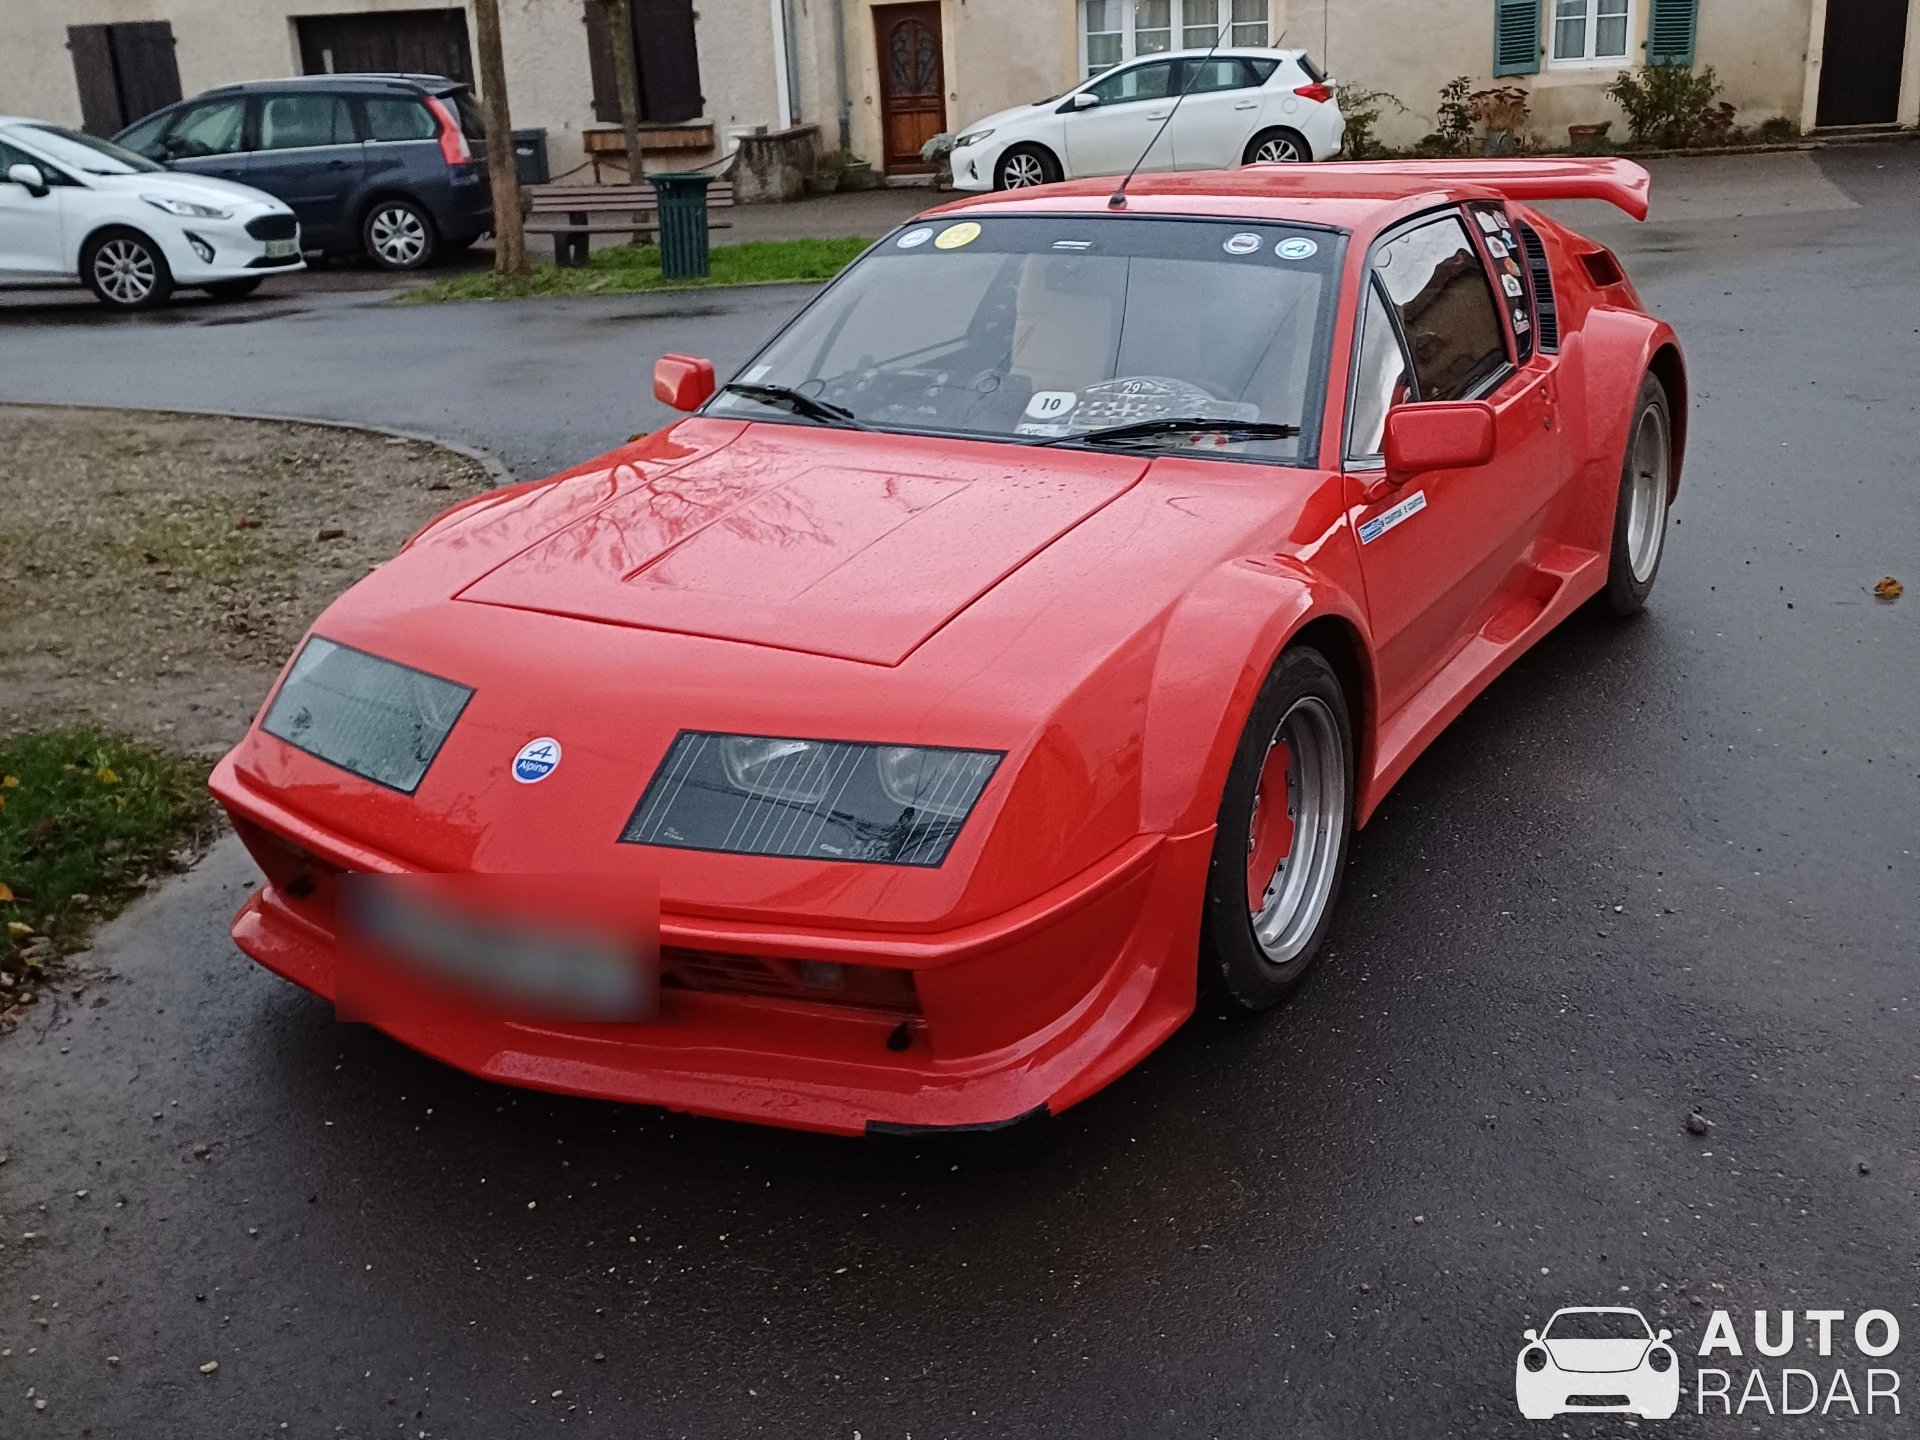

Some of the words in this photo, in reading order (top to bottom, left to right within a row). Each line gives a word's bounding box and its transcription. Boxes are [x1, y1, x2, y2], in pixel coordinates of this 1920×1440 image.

[1122, 380, 1142, 394] 29
[1041, 398, 1062, 411] 10
[517, 760, 549, 774] Alpine
